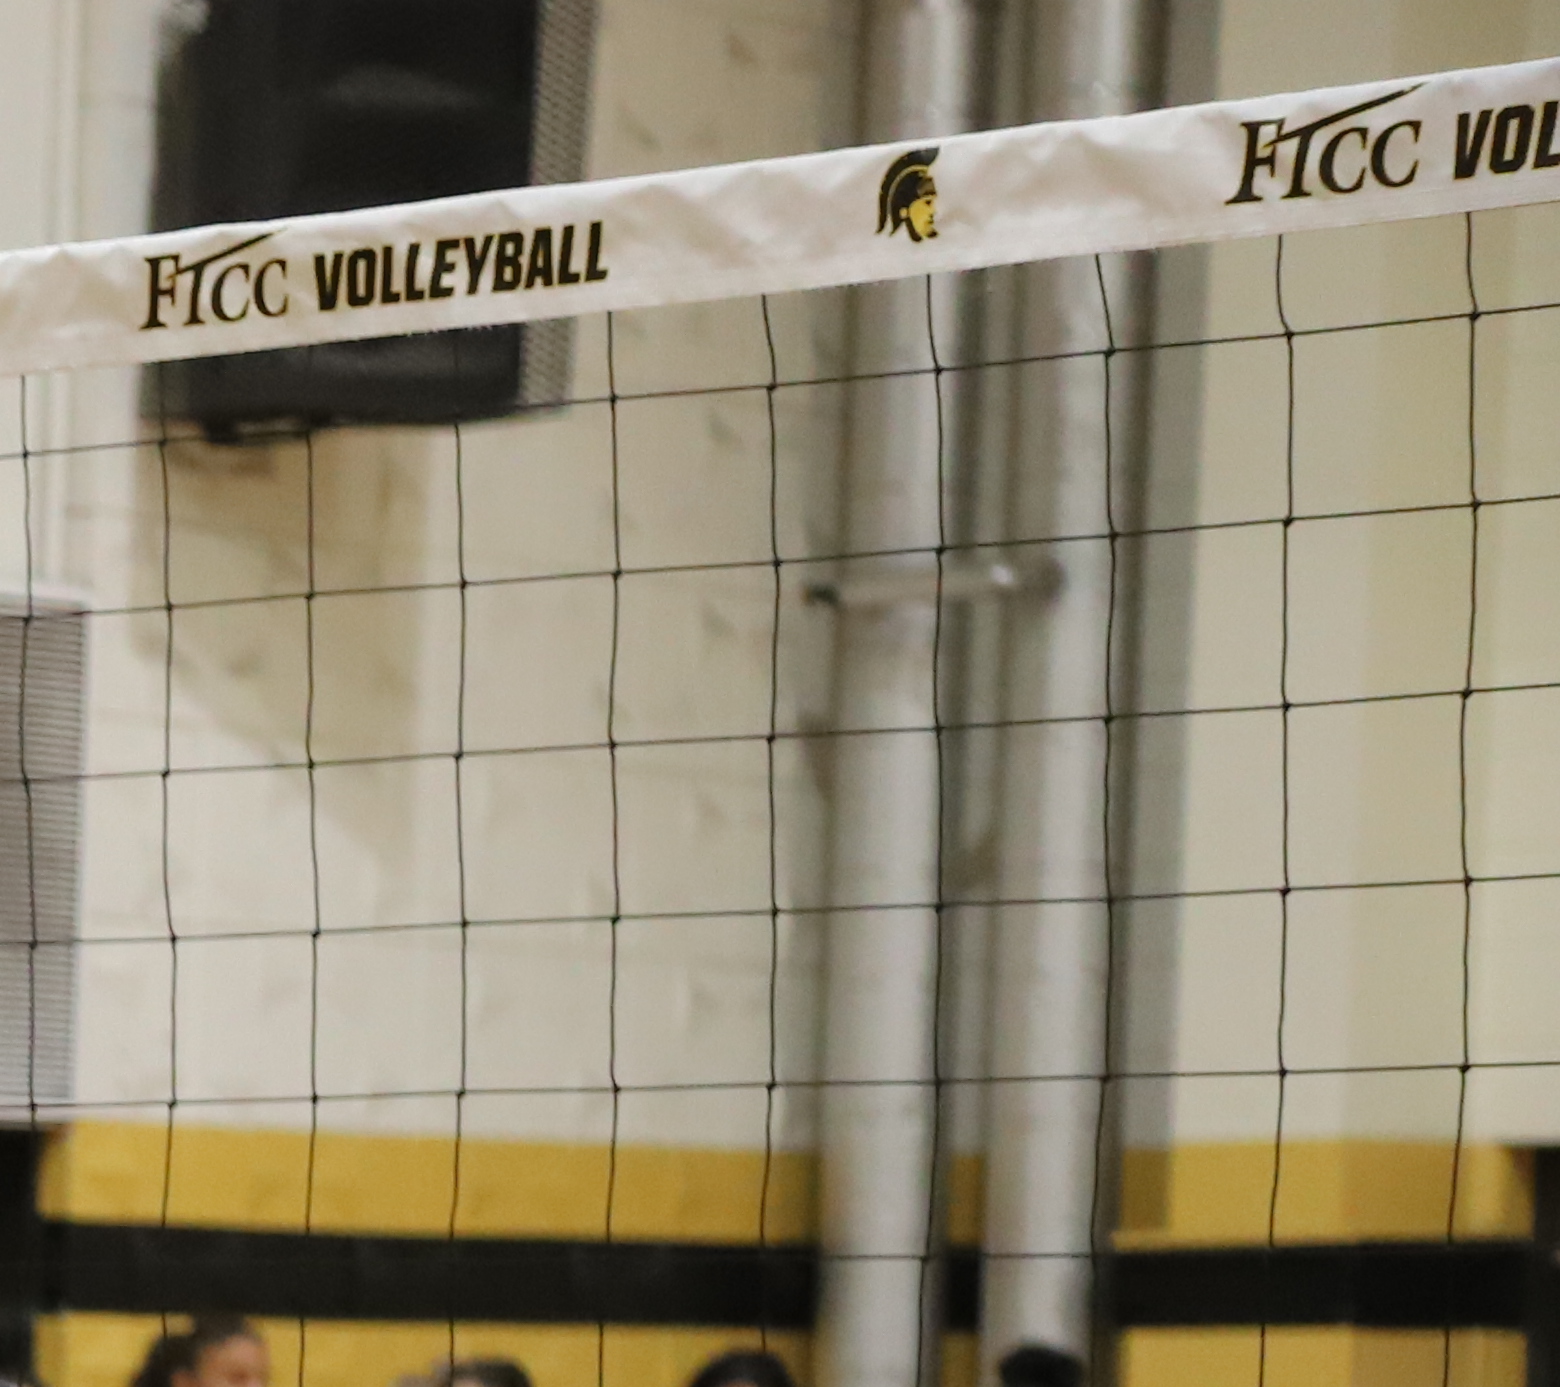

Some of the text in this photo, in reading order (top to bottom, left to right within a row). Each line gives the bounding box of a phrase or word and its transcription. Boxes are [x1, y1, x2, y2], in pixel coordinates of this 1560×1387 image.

[1224, 81, 1430, 206] FTCC
[140, 221, 608, 331] FTCC VOLLEYBALL
